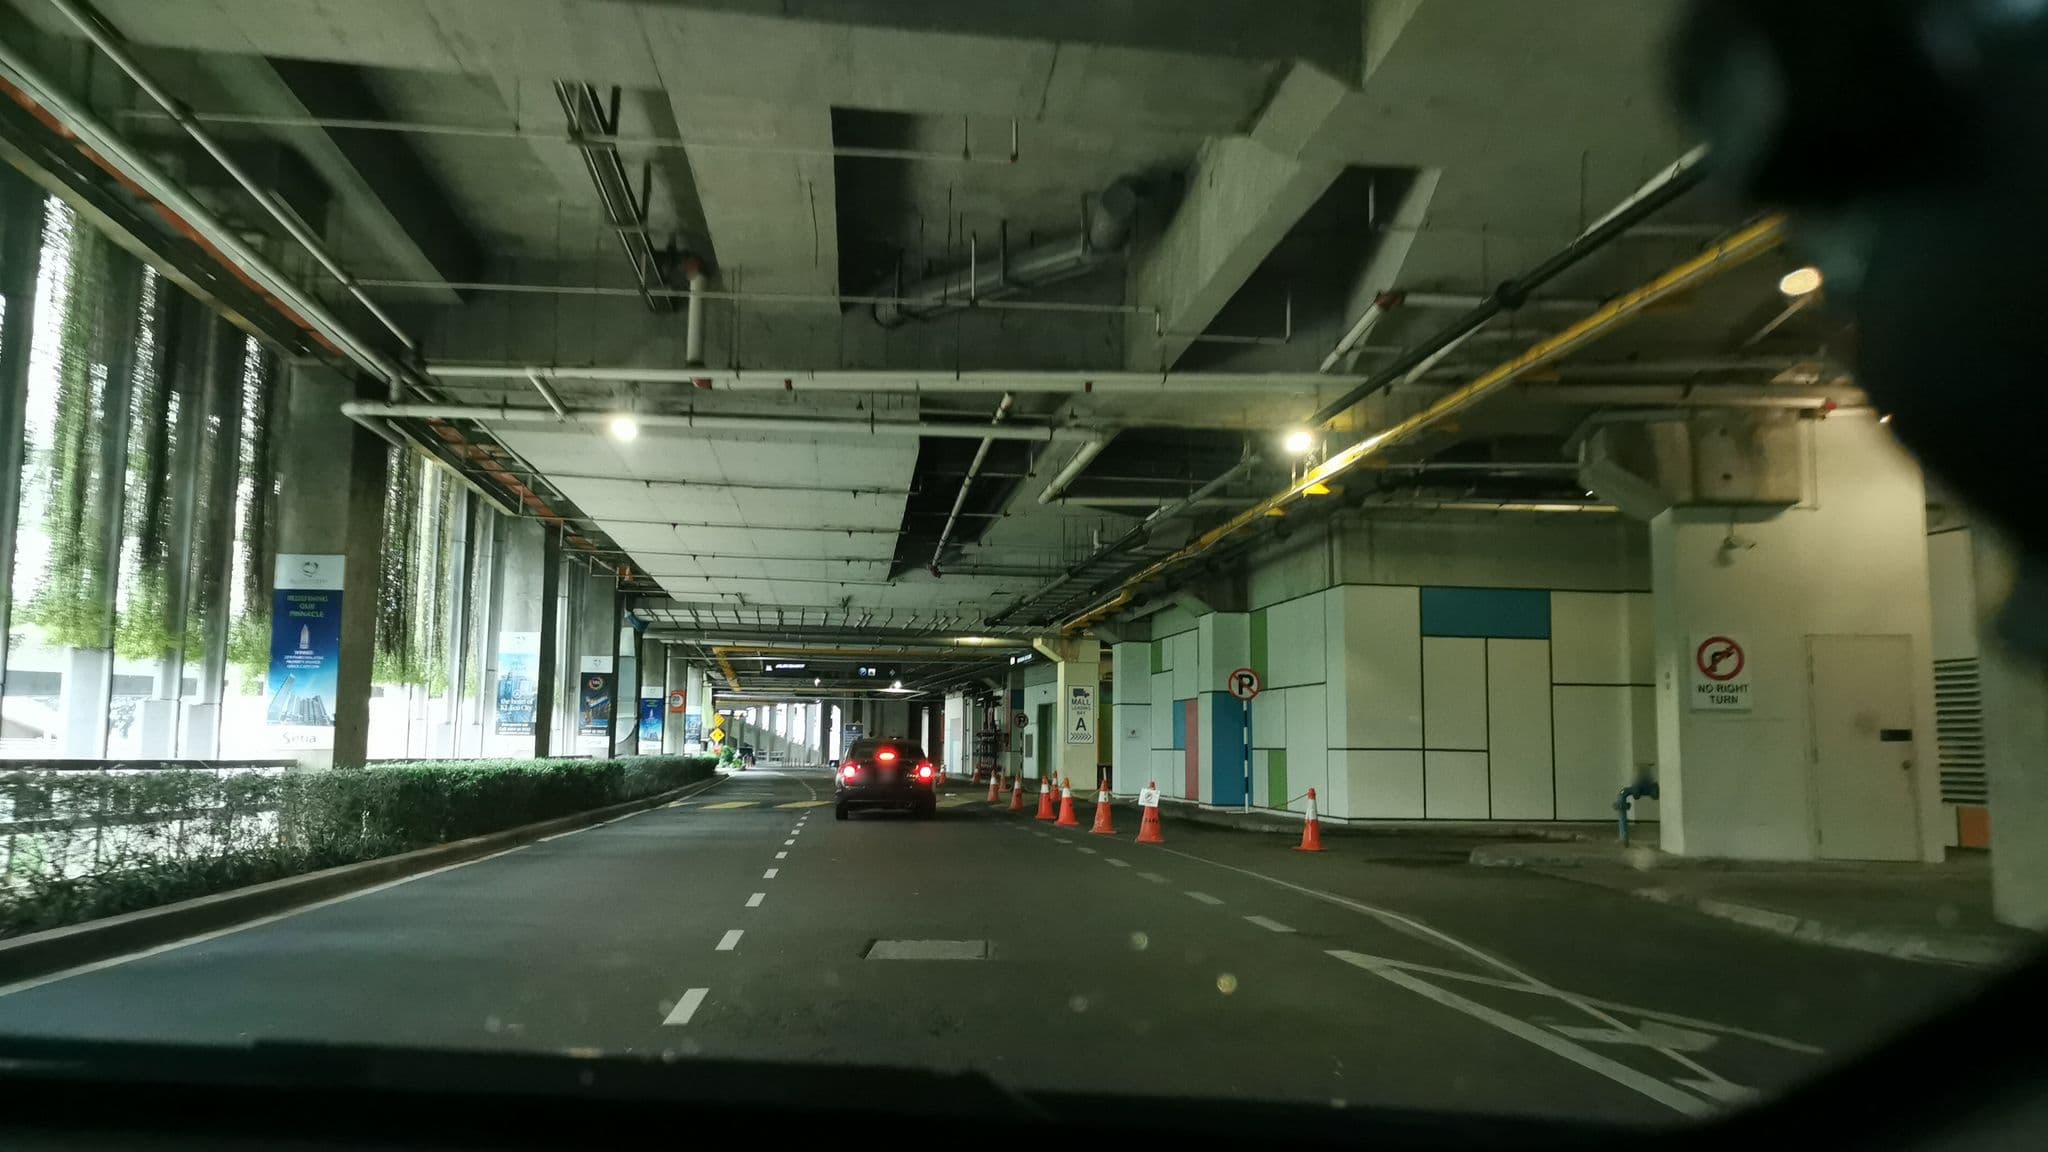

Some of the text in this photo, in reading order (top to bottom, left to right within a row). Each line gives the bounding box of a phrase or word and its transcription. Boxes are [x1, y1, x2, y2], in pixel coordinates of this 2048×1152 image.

[288, 610, 325, 618] PINNACLE
[1238, 673, 1254, 695] P
[1697, 683, 1749, 694] NO RIGHT
[1071, 698, 1091, 706] MALL
[1709, 695, 1739, 704] TURN
[1075, 717, 1087, 732] A
